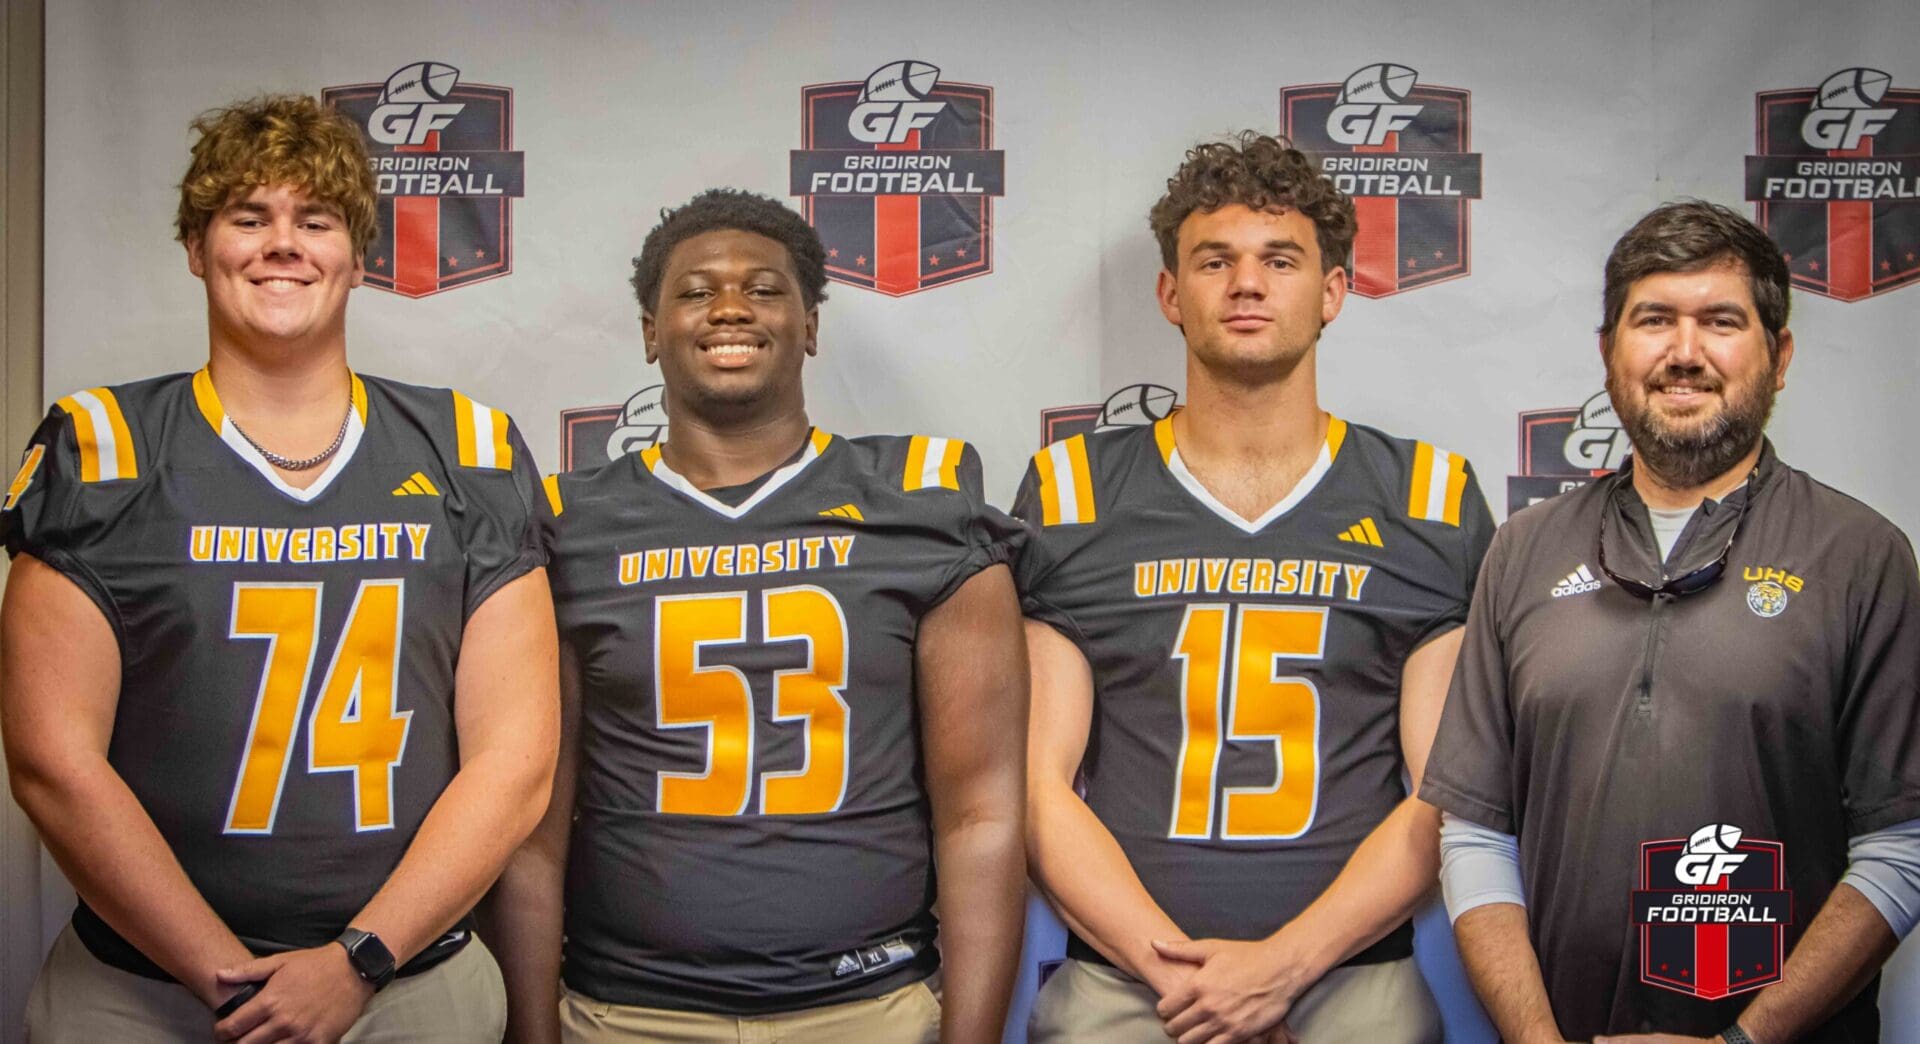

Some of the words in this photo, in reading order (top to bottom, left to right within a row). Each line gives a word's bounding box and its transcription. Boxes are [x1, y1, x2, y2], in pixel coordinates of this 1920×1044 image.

[368, 103, 466, 145] GF
[848, 102, 947, 143] GF
[1326, 104, 1424, 145] GF
[1801, 108, 1898, 149] GF
[810, 172, 984, 193] FOOTBALL
[844, 155, 951, 169] GRIDIRON
[1322, 157, 1428, 172] GRIDIRON
[1797, 161, 1902, 176] GRIDIRON
[376, 173, 503, 195] OTBALL
[1317, 174, 1462, 195] OTBALL
[190, 523, 431, 563] UNIVERSITY
[618, 535, 856, 585] UNIVERSITY
[1134, 558, 1372, 601] UNIVERSITY
[1551, 579, 1601, 597] adidas
[222, 578, 414, 835] 74
[654, 584, 850, 816] 53
[1168, 603, 1330, 841] 15
